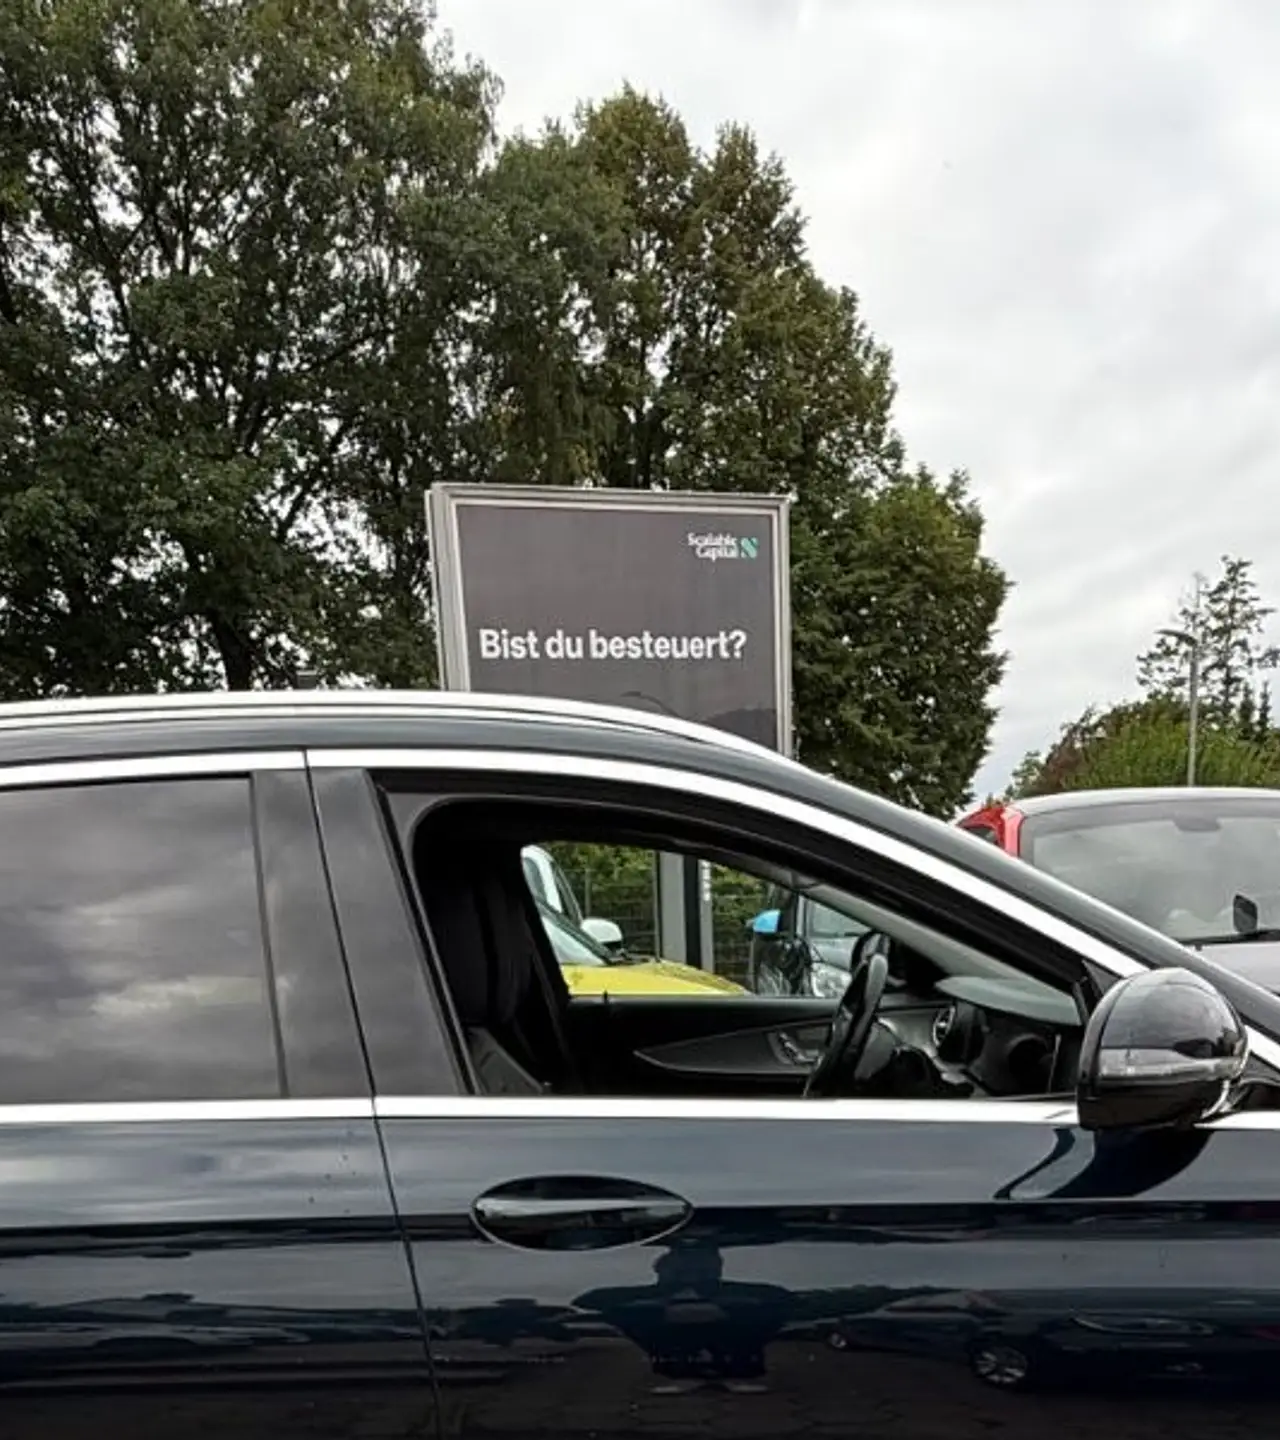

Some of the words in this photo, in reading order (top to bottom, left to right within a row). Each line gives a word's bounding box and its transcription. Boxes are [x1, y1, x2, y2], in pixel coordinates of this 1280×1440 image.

[479, 629, 539, 660] Bist
[545, 630, 583, 660] du
[590, 630, 747, 660] besteuert?
